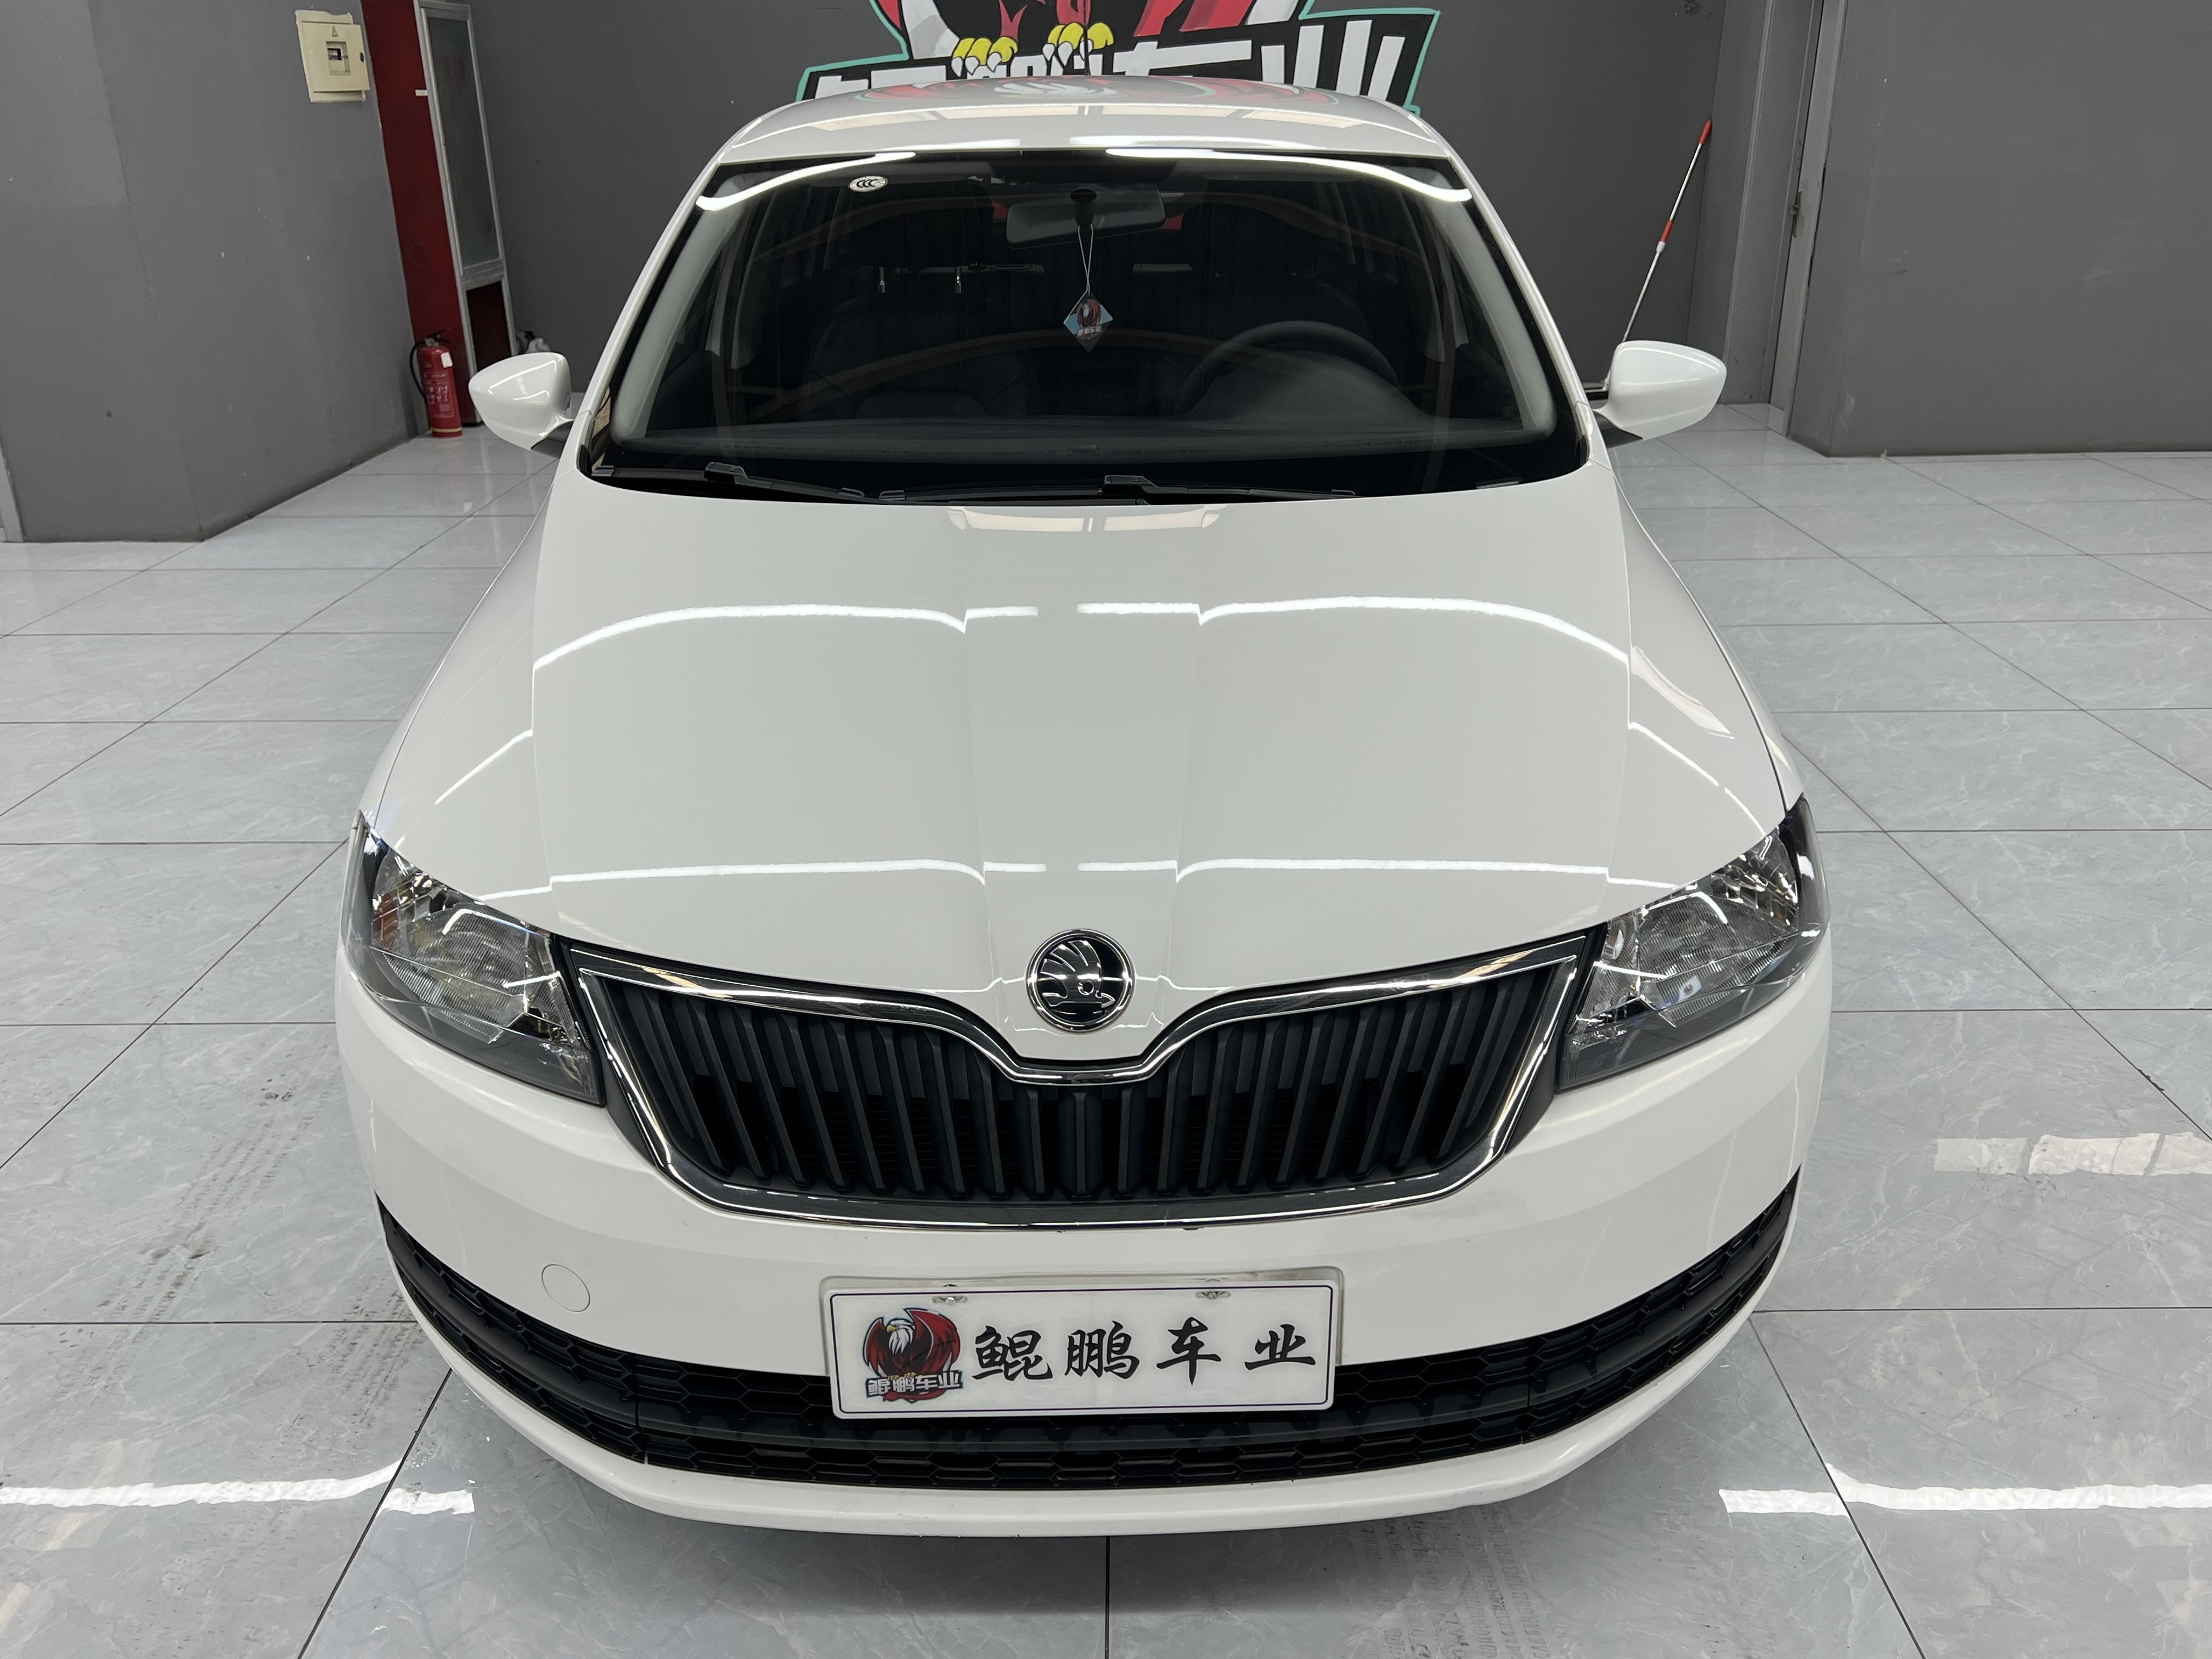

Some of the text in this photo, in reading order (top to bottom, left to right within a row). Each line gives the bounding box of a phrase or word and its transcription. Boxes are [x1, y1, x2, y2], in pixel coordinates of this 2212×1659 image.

[856, 178, 878, 188] CCC
[972, 1317, 1316, 1386] 鲲鹏车业
[868, 1372, 960, 1395] 鲲鹏车业
